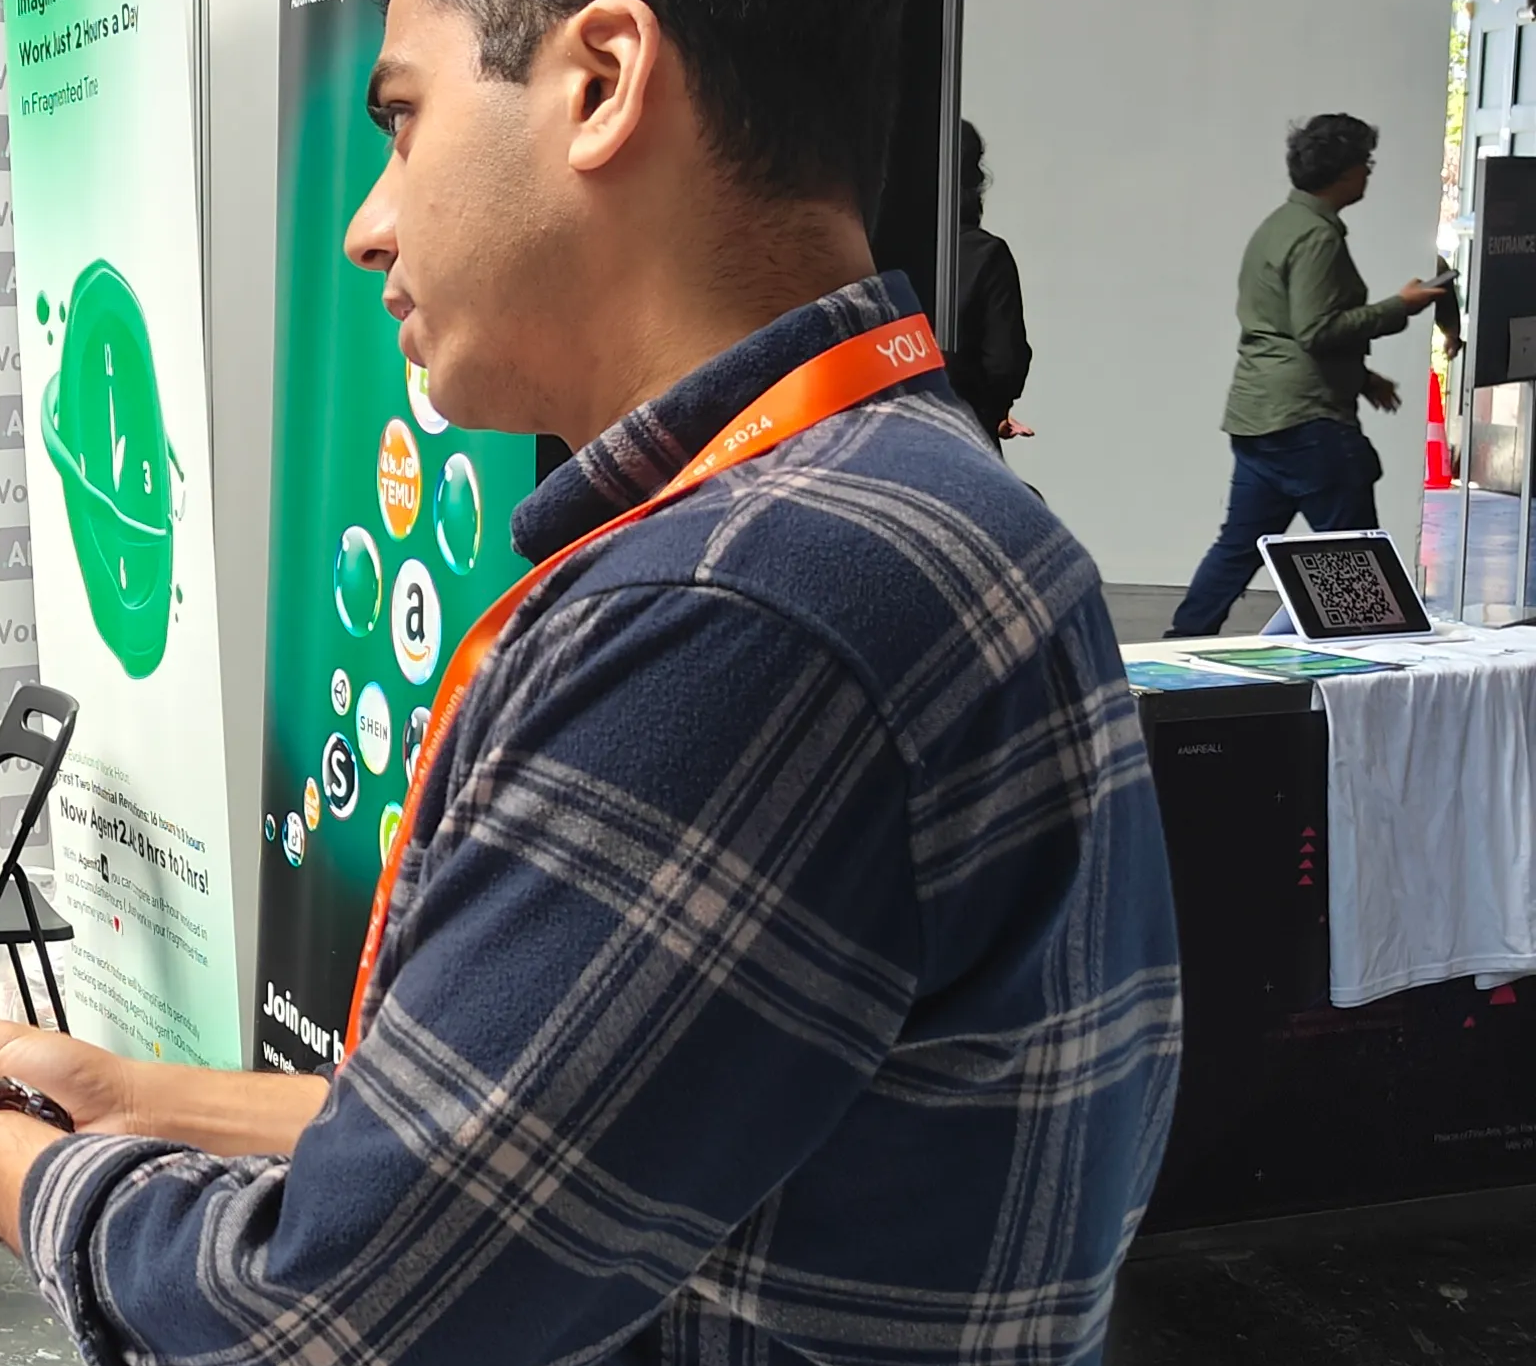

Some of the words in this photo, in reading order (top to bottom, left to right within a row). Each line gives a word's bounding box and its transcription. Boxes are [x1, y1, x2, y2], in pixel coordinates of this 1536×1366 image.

[18, 35, 52, 67] Work
[52, 25, 72, 58] Just
[74, 22, 82, 49] 2
[111, 13, 119, 35] a
[122, 2, 139, 33] Day
[21, 95, 31, 116] In
[723, 414, 774, 453] 2024
[142, 460, 152, 495] 3
[381, 477, 415, 510] TEMU
[405, 581, 426, 643] a
[360, 715, 388, 741] SHEIN
[60, 795, 87, 827] Now
[138, 831, 145, 858] 8
[147, 836, 166, 869] hrs
[168, 847, 179, 878] to
[186, 859, 210, 896] hrs!
[263, 981, 299, 1035] Join
[300, 1016, 331, 1058] our
[262, 1040, 279, 1067] We
